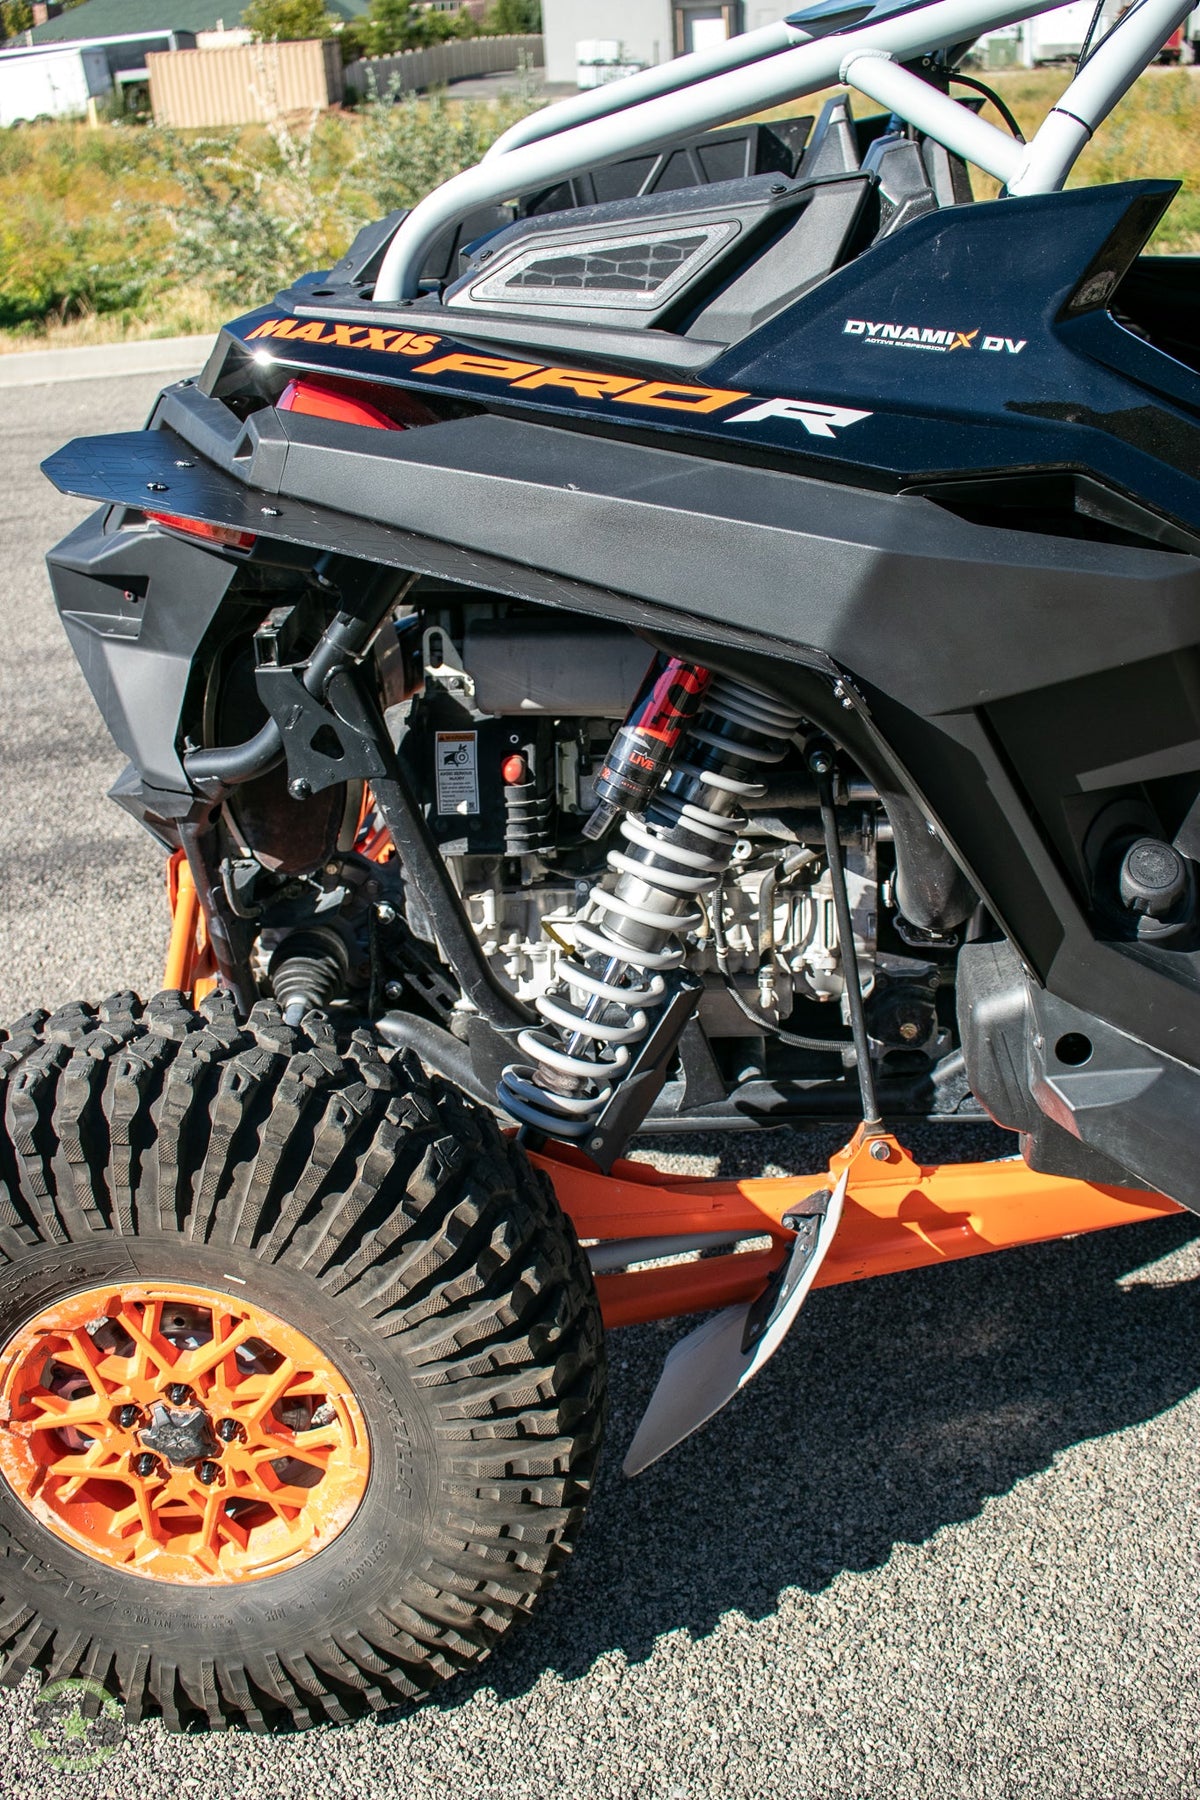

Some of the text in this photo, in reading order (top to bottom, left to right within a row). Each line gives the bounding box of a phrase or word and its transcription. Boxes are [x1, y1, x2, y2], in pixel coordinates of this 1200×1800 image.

[244, 319, 442, 355] MAXXIS
[844, 319, 1027, 354] DYNAMIX DV
[864, 337, 947, 352] ACTIVE SUSPENSION
[411, 353, 875, 439] PRO R
[629, 751, 655, 771] LIVE
